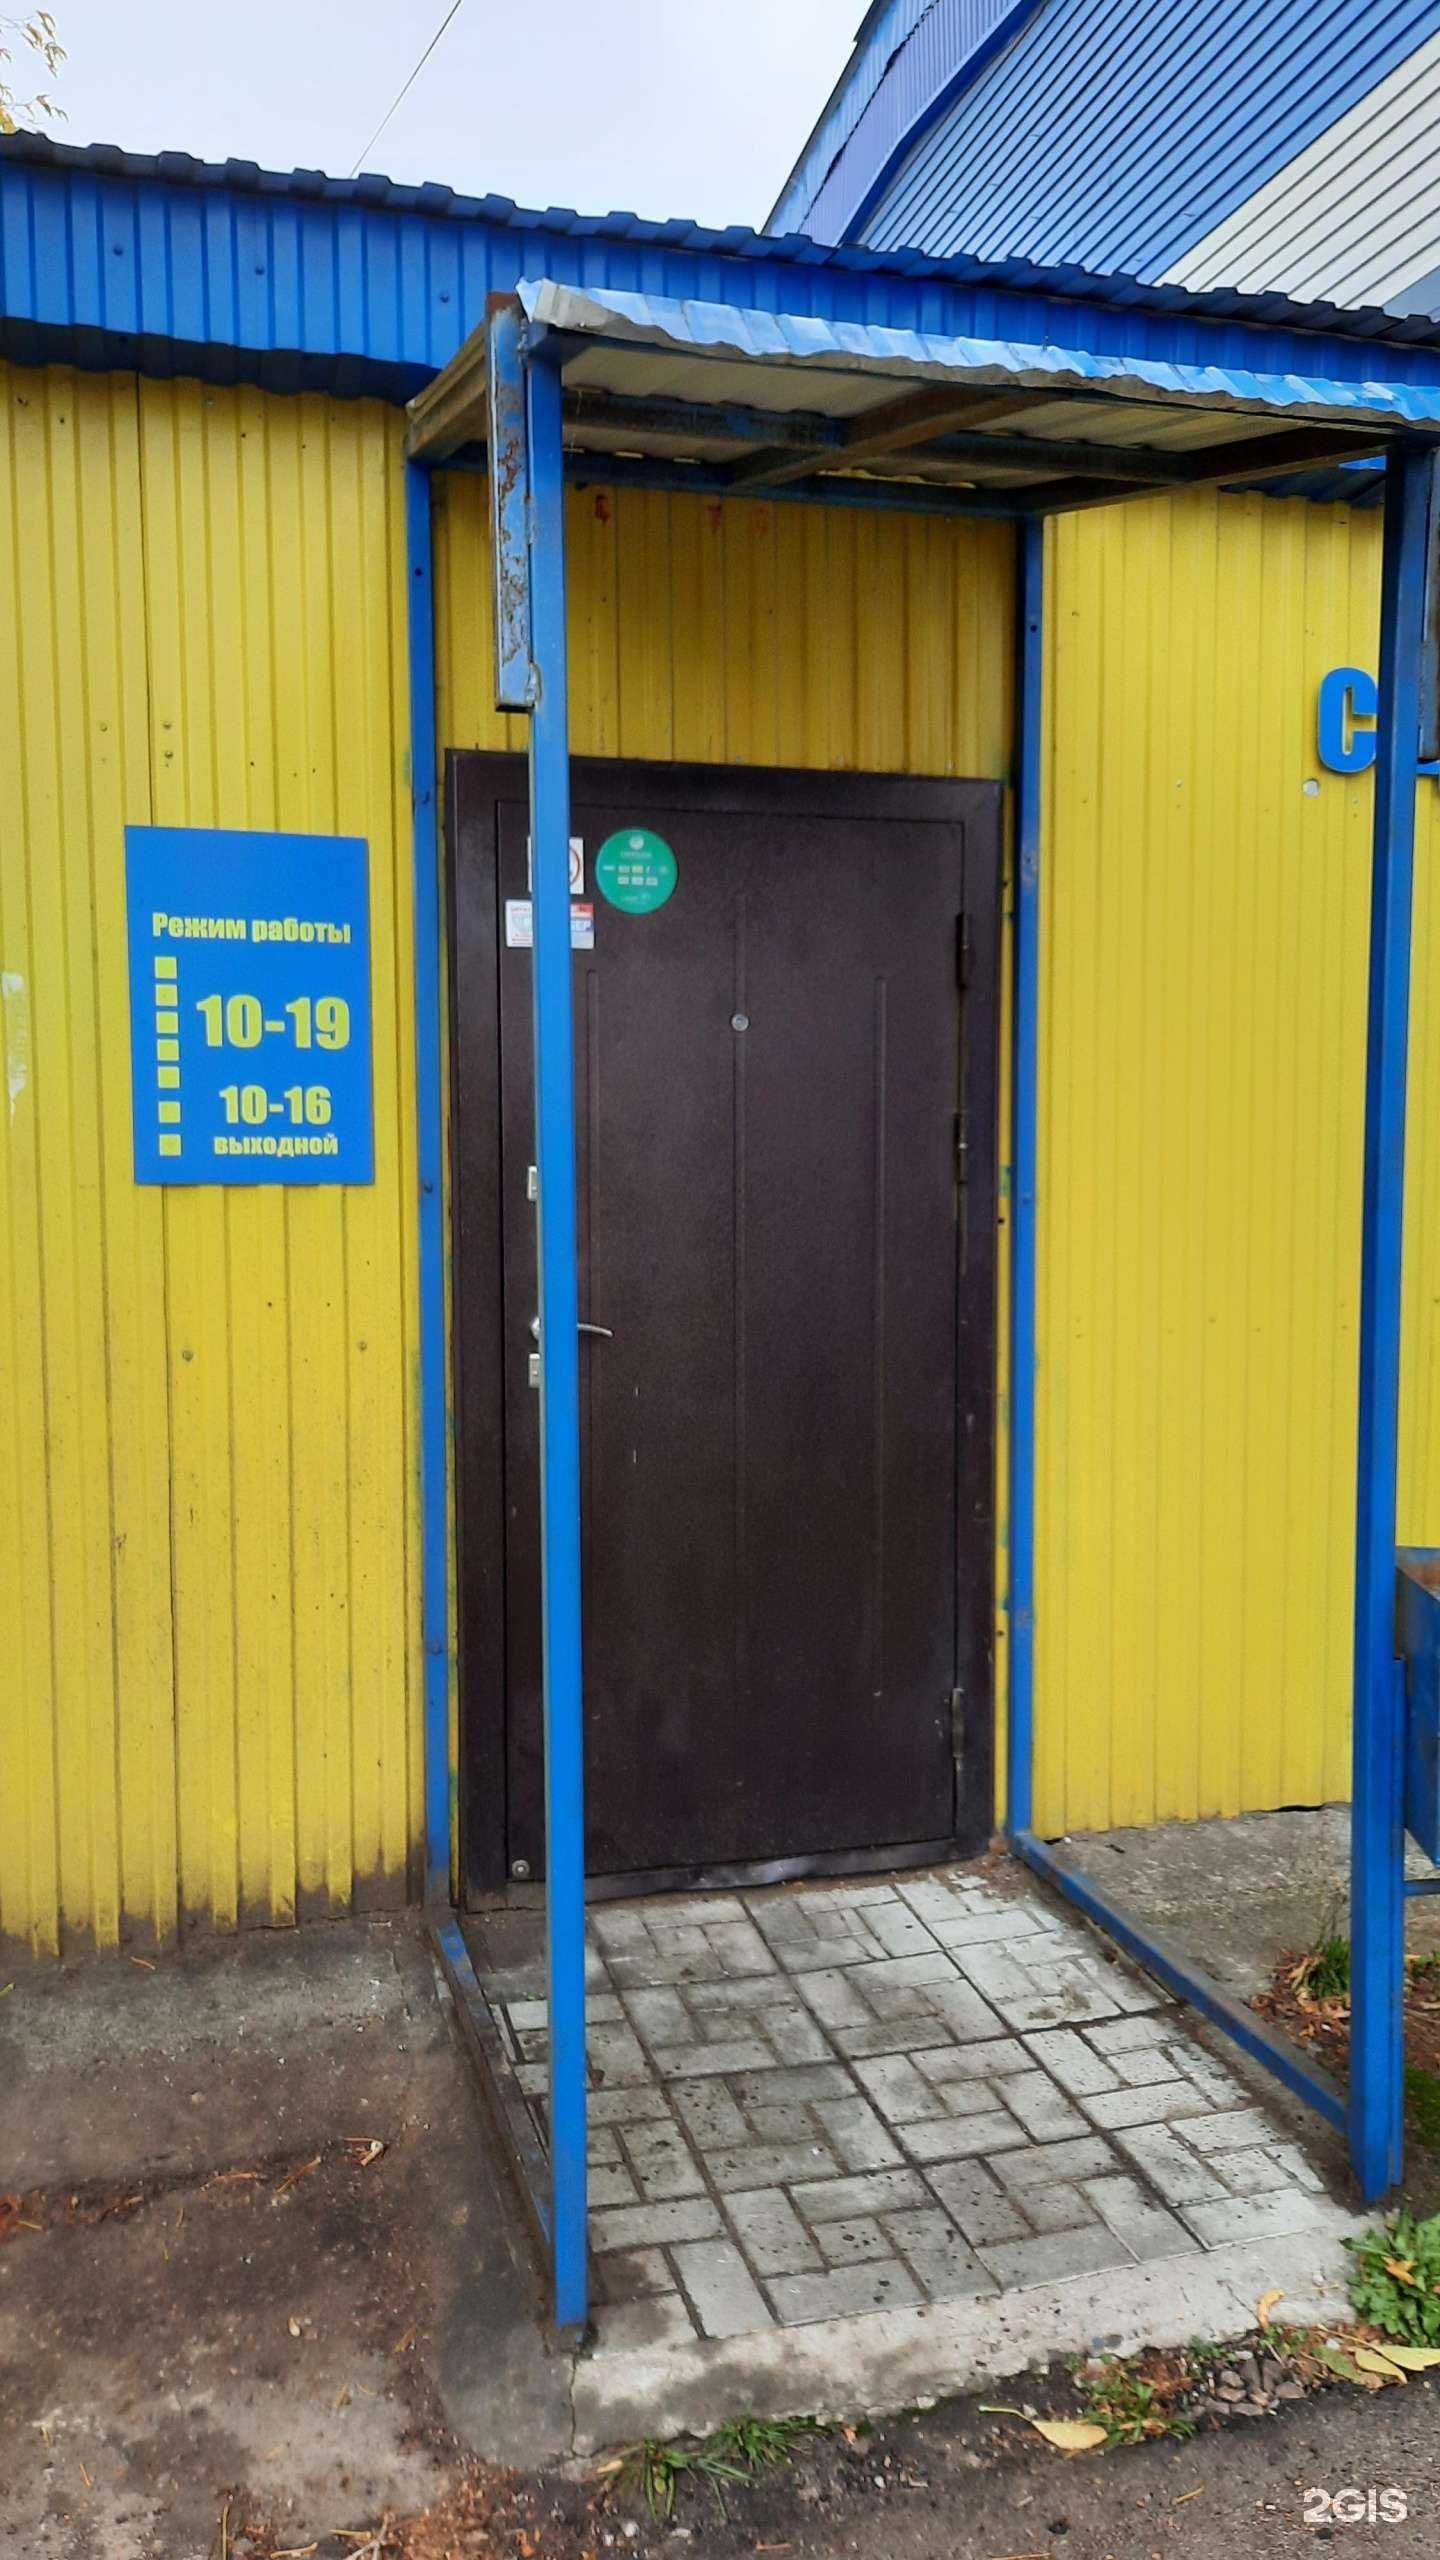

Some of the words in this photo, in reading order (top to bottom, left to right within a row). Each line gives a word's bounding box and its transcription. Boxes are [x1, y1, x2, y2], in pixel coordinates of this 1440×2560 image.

[152, 912, 246, 940] Режим
[252, 917, 351, 944] работы
[196, 994, 350, 1050] 10-19
[218, 1085, 332, 1125] 10-16
[213, 1132, 339, 1158] выходной
